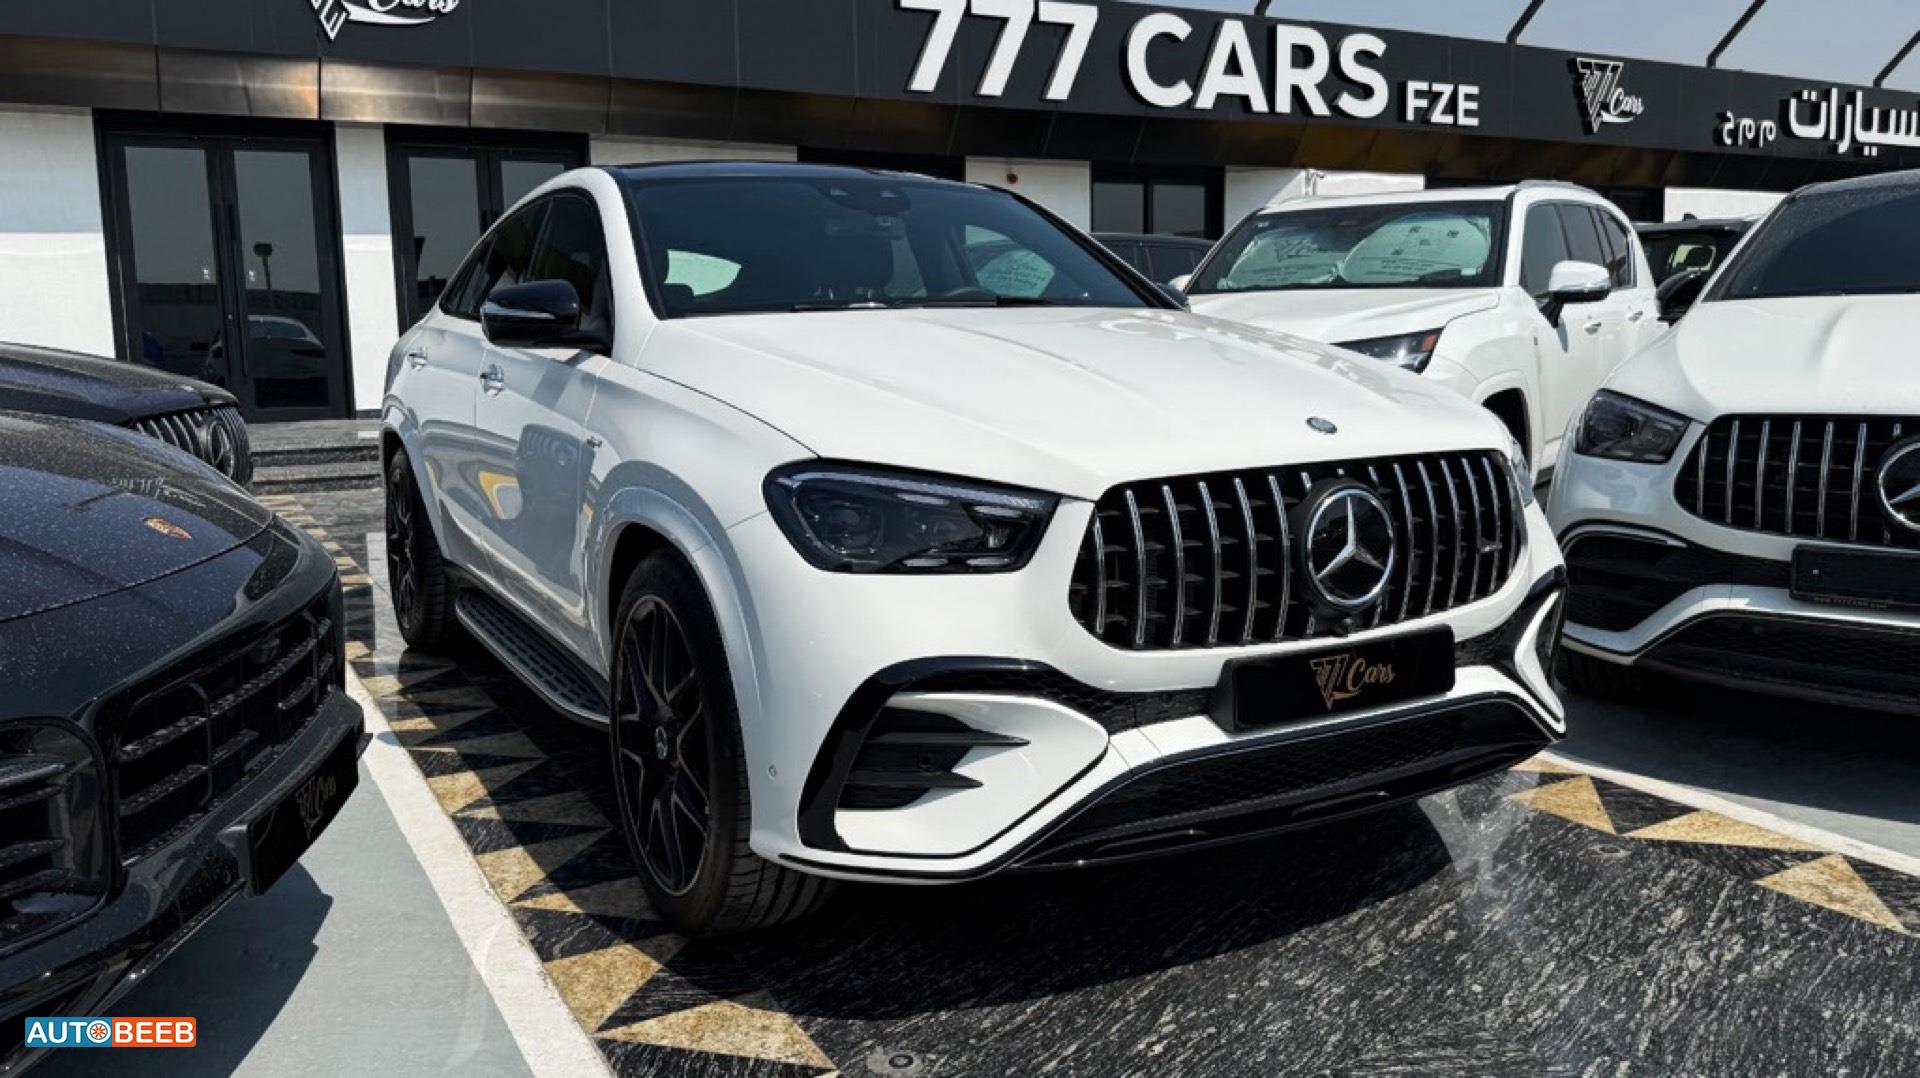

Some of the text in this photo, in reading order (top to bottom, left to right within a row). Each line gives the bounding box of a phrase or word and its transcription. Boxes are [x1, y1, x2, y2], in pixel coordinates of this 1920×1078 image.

[899, 0, 1480, 126] 777 CARS FZE
[1610, 87, 1645, 115] Cars
[1346, 657, 1396, 692] Cars
